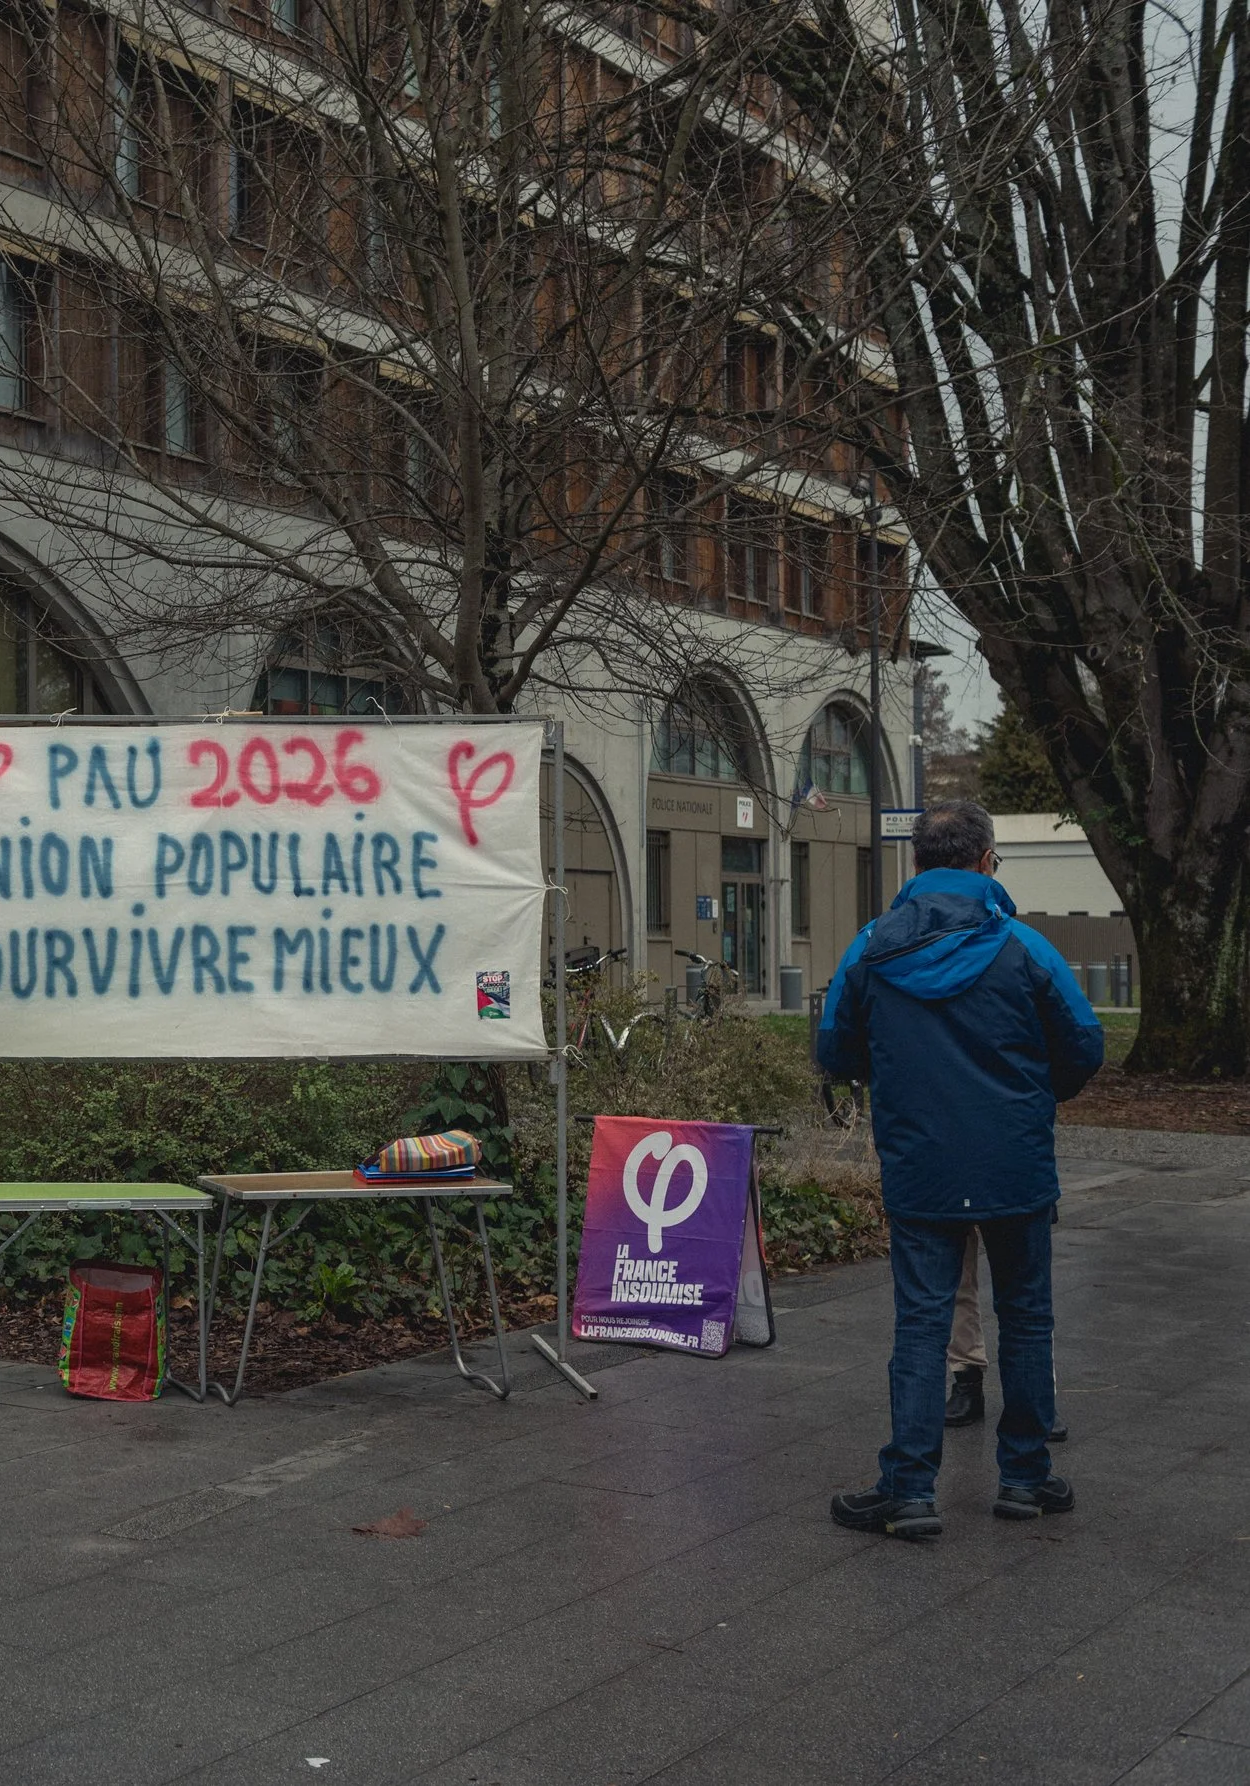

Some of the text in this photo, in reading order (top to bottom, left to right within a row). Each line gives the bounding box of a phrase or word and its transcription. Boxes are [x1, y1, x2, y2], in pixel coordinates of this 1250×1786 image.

[47, 730, 382, 809] PAU 2026
[652, 798, 713, 815] POLICE NATIONALE
[154, 812, 443, 899] POPULAiRE
[272, 907, 447, 995] MiEUX
[616, 1244, 629, 1259] LA
[613, 1259, 678, 1285] FRANCE
[581, 1315, 650, 1326] POUR NOUS REJOINDRE
[581, 1325, 699, 1349] LAFRANCEINSOUMISE.FR
